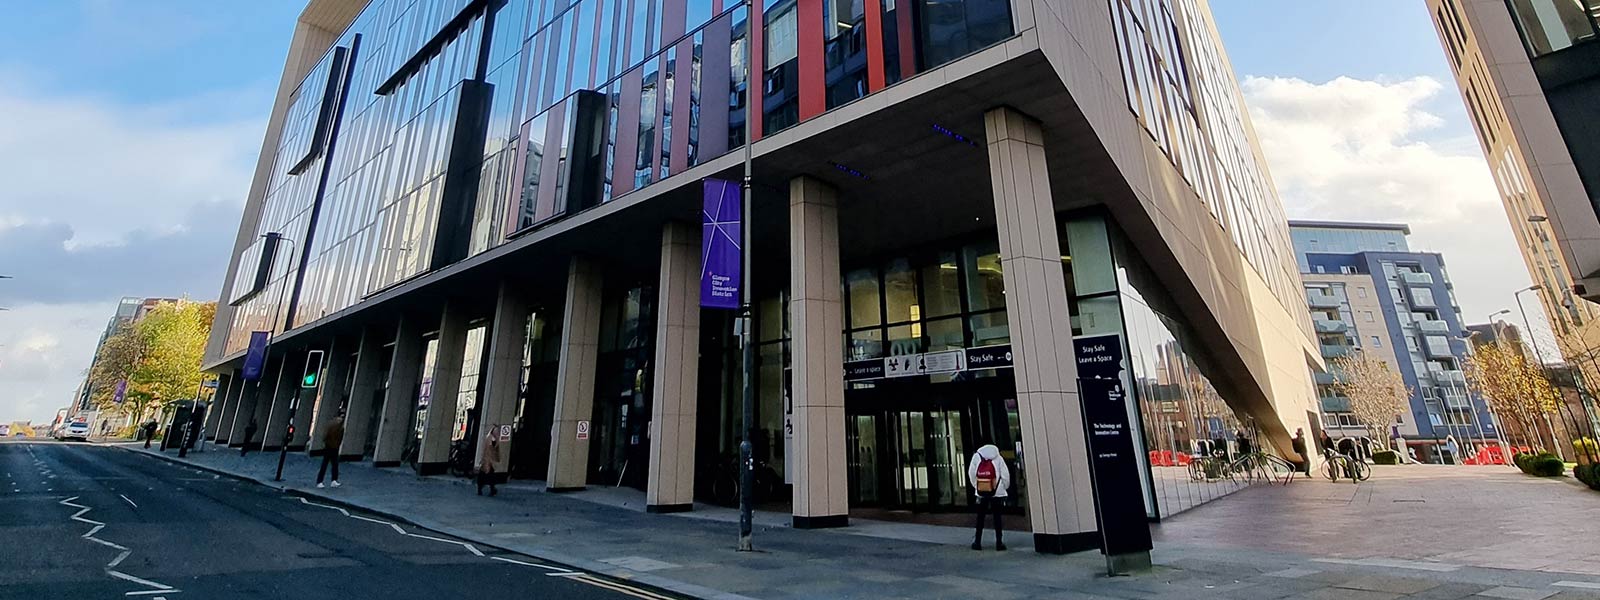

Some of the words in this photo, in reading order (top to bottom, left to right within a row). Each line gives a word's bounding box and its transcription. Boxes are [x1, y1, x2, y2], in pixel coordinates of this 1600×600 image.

[1082, 345, 1094, 354] Stay
[1094, 344, 1105, 352] Safe
[970, 355, 981, 363] Stay
[982, 353, 994, 361] Safe
[1097, 355, 1112, 363] Space
